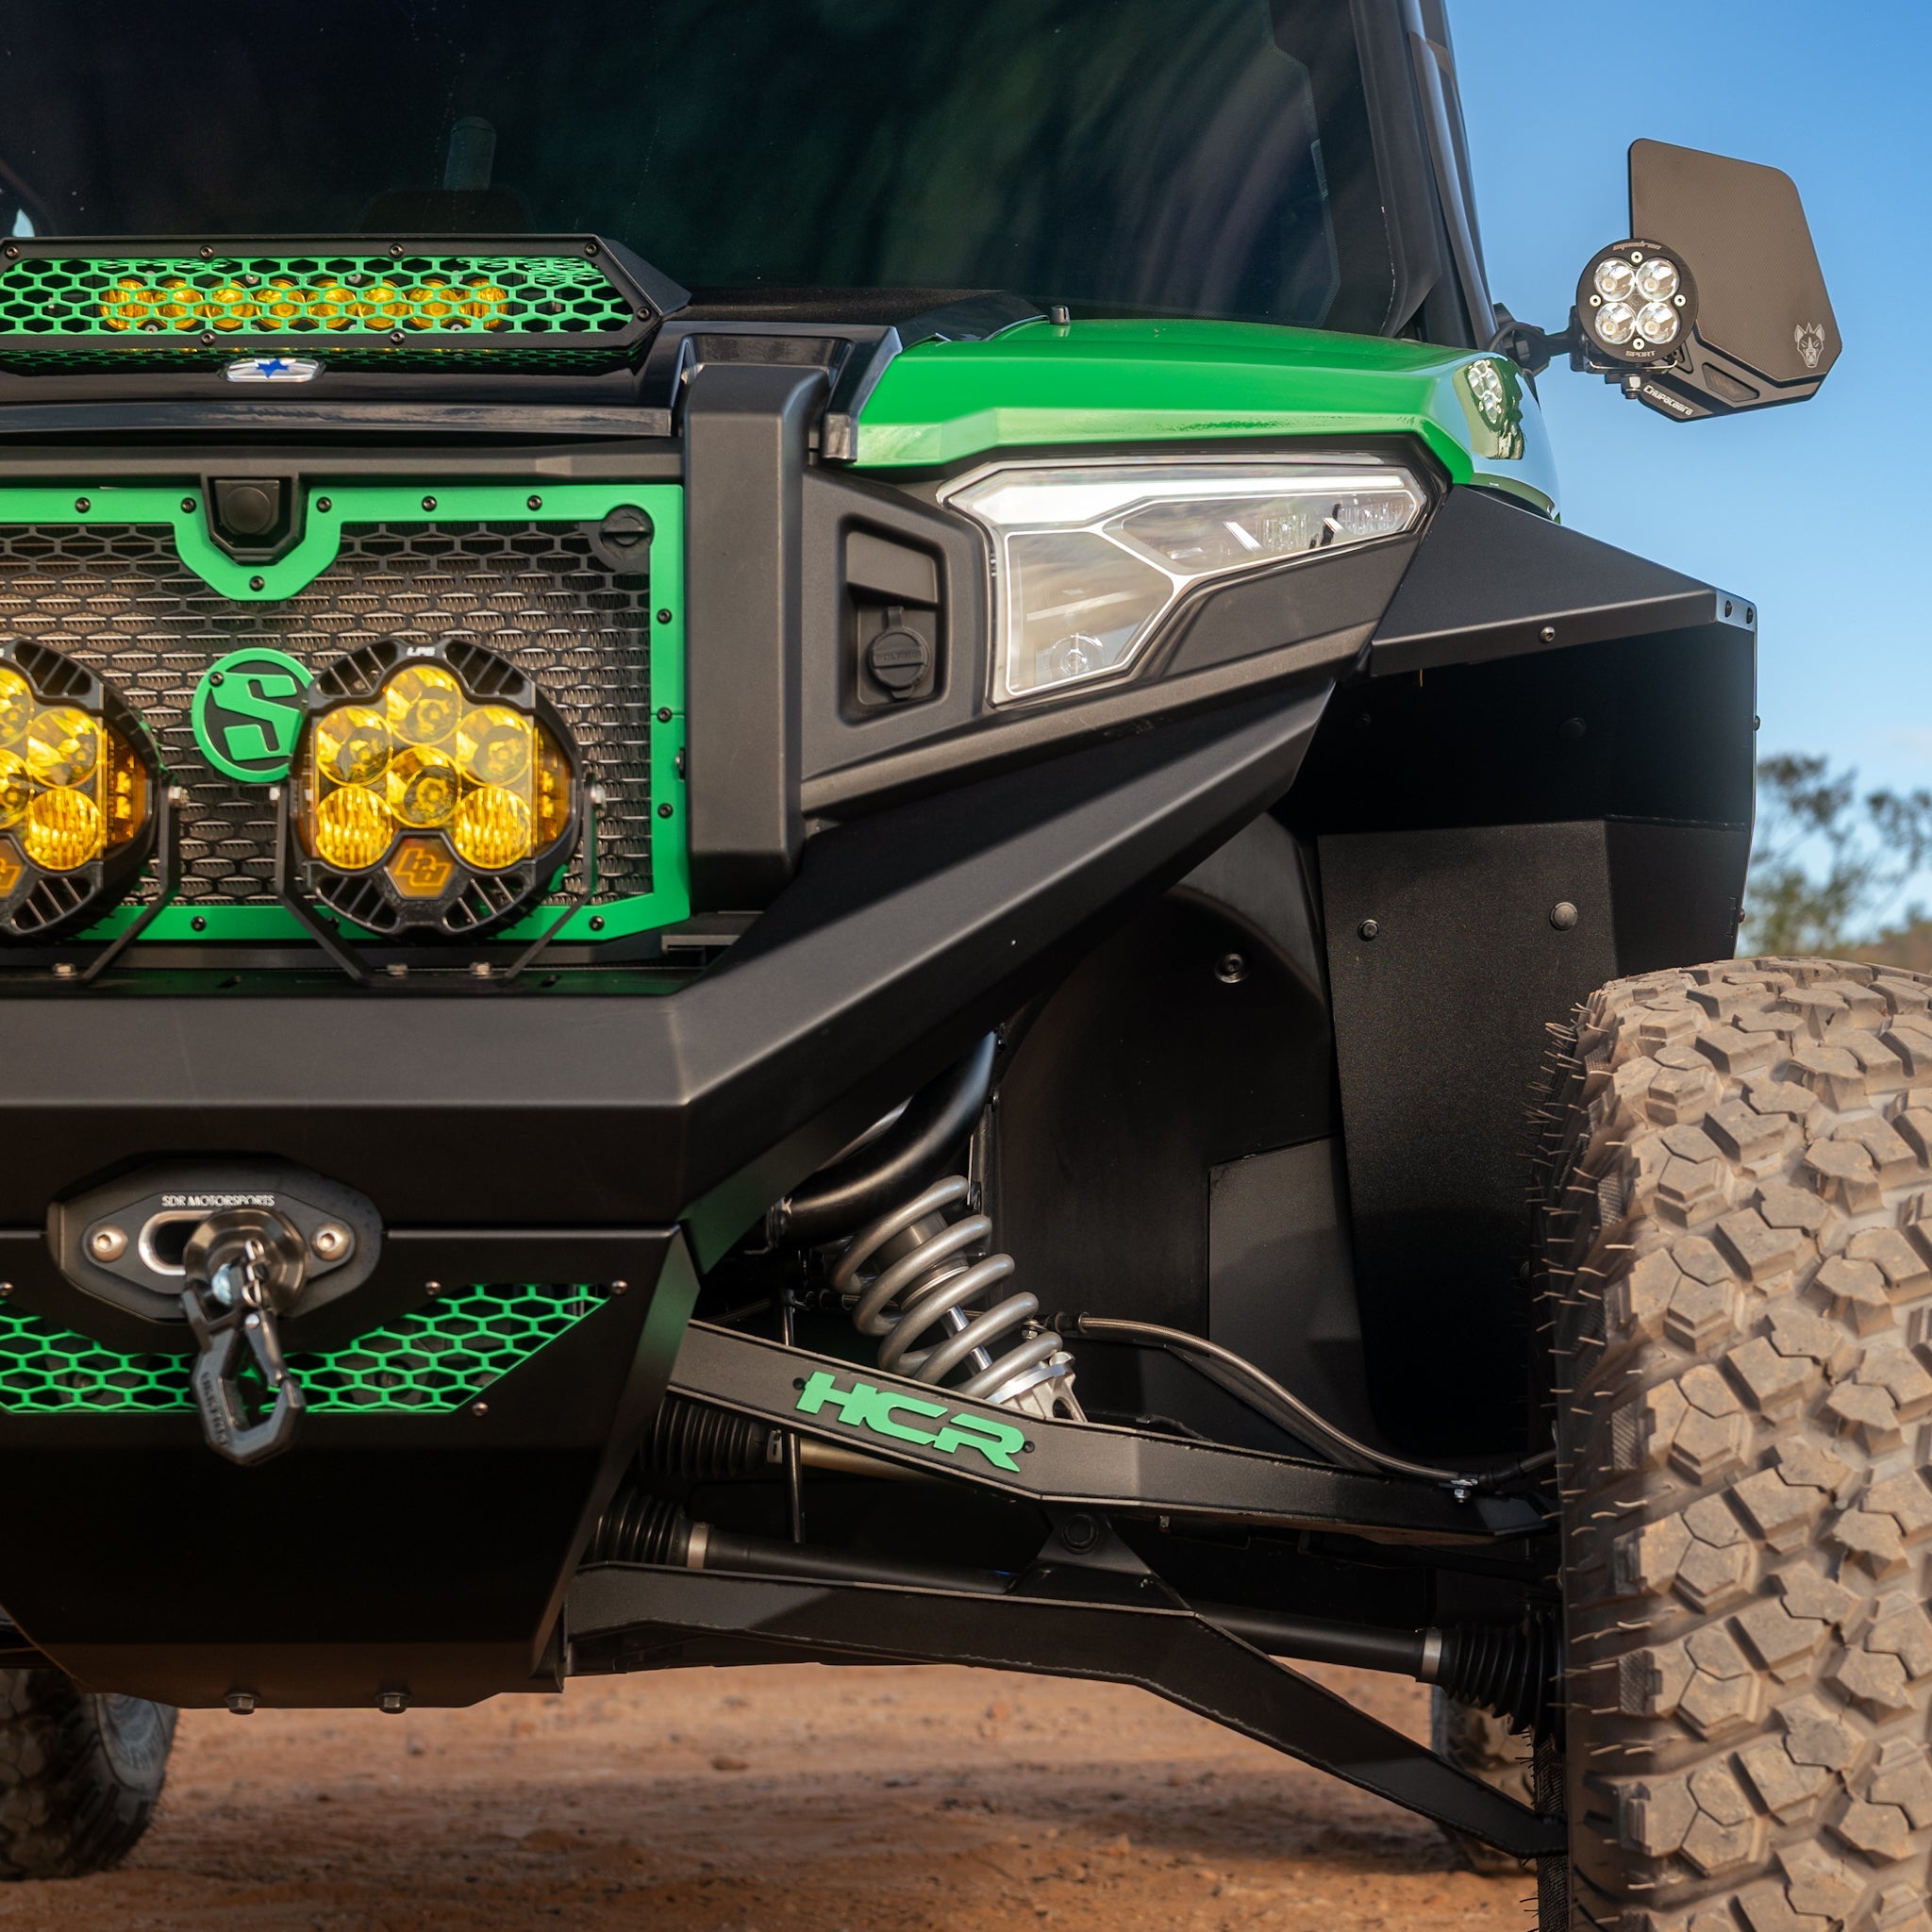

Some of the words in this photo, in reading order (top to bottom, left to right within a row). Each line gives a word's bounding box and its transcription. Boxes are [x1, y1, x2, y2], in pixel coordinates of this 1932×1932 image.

[161, 1194, 187, 1207] SDR
[188, 1194, 275, 1207] MOTORSPORTS
[795, 1371, 1025, 1473] HCR
